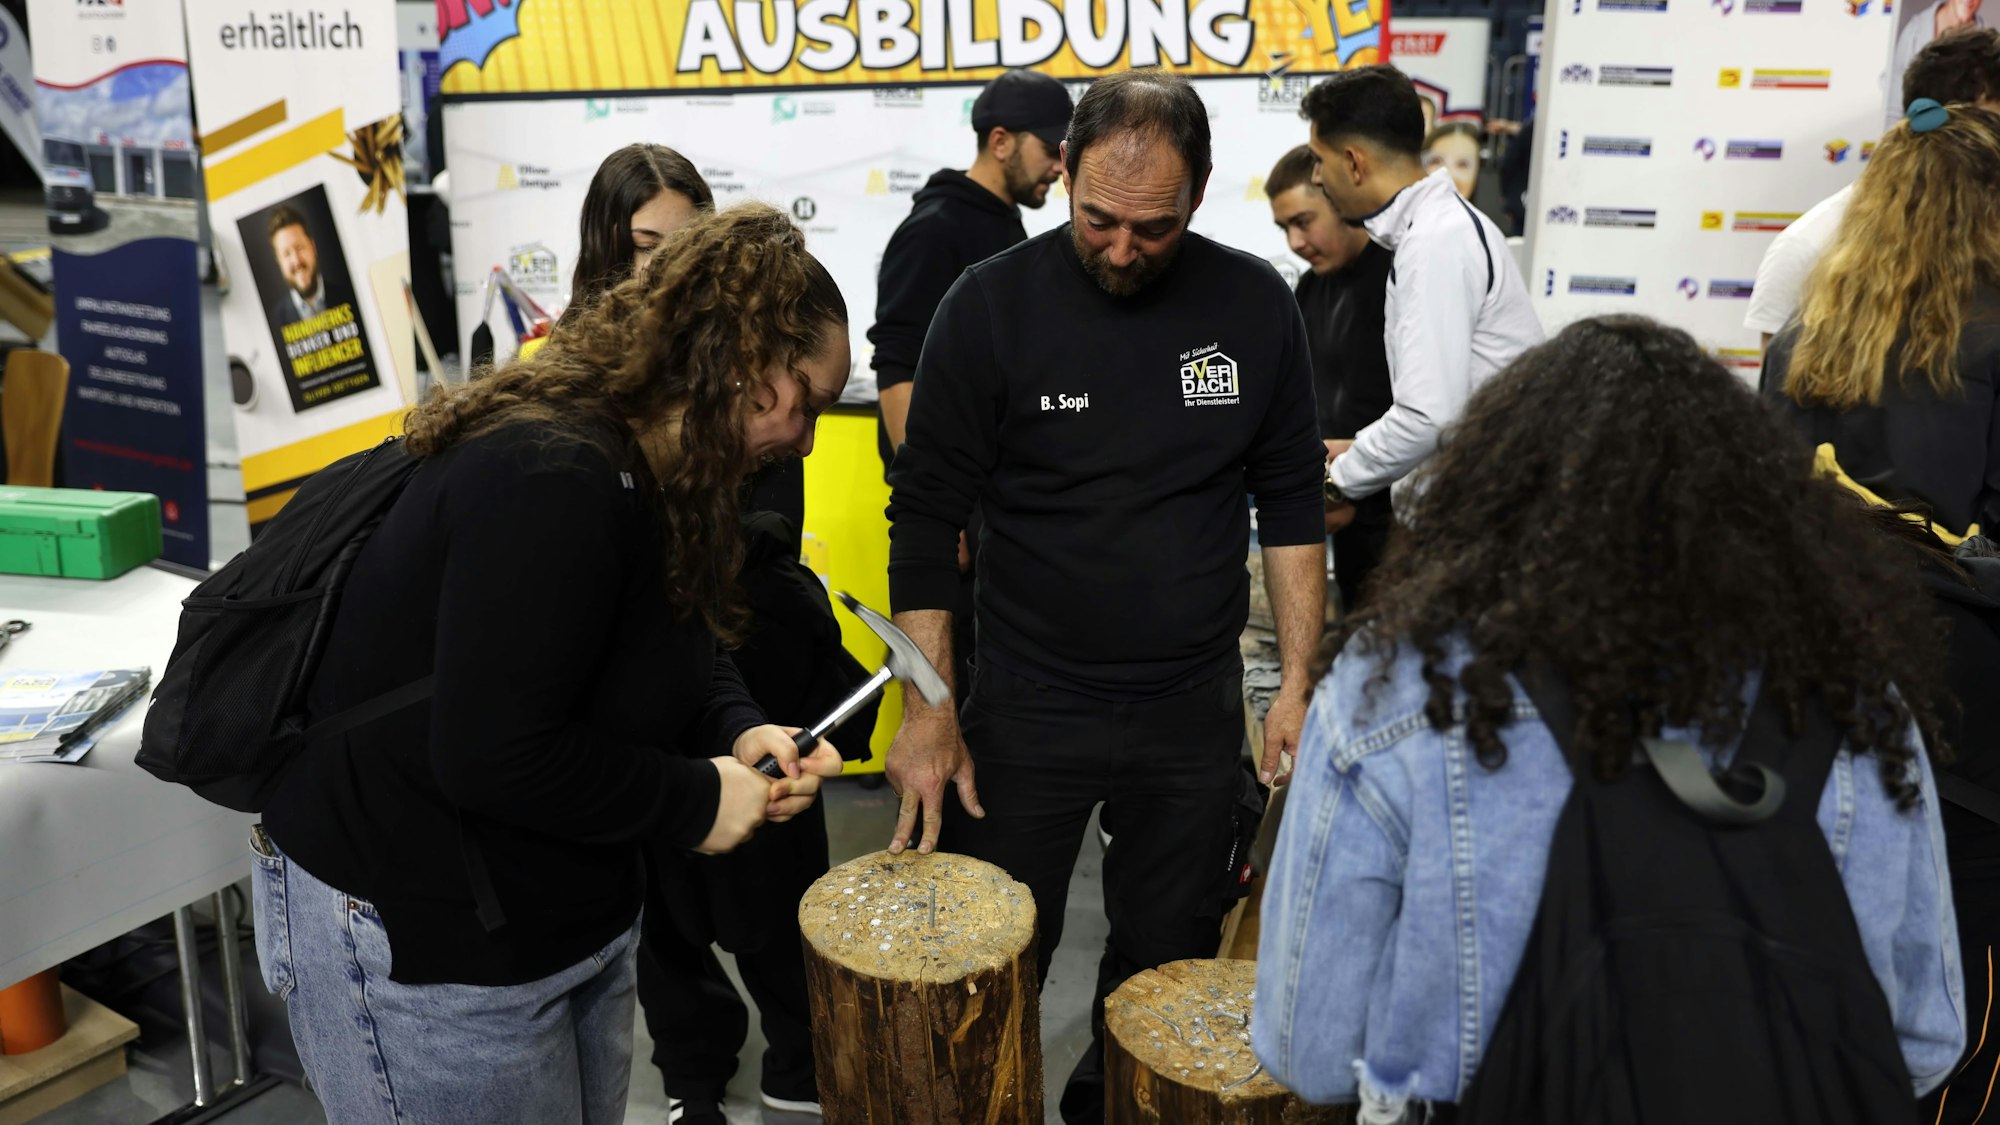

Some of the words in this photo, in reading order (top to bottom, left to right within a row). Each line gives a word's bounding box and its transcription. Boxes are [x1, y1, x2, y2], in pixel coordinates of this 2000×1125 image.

[220, 11, 363, 48] erhältlich
[676, 0, 1256, 73] AUSBILDUNG
[292, 338, 364, 378] INFLUENCER
[1180, 351, 1190, 361] Mit
[1192, 342, 1219, 357] Sicherheit
[1180, 359, 1231, 379] OVER
[1182, 378, 1232, 395] DACH
[1041, 396, 1055, 410] B.
[1059, 393, 1089, 412] Sopi
[1184, 399, 1195, 407] Ihr
[1197, 397, 1240, 406] Dienstleister!
